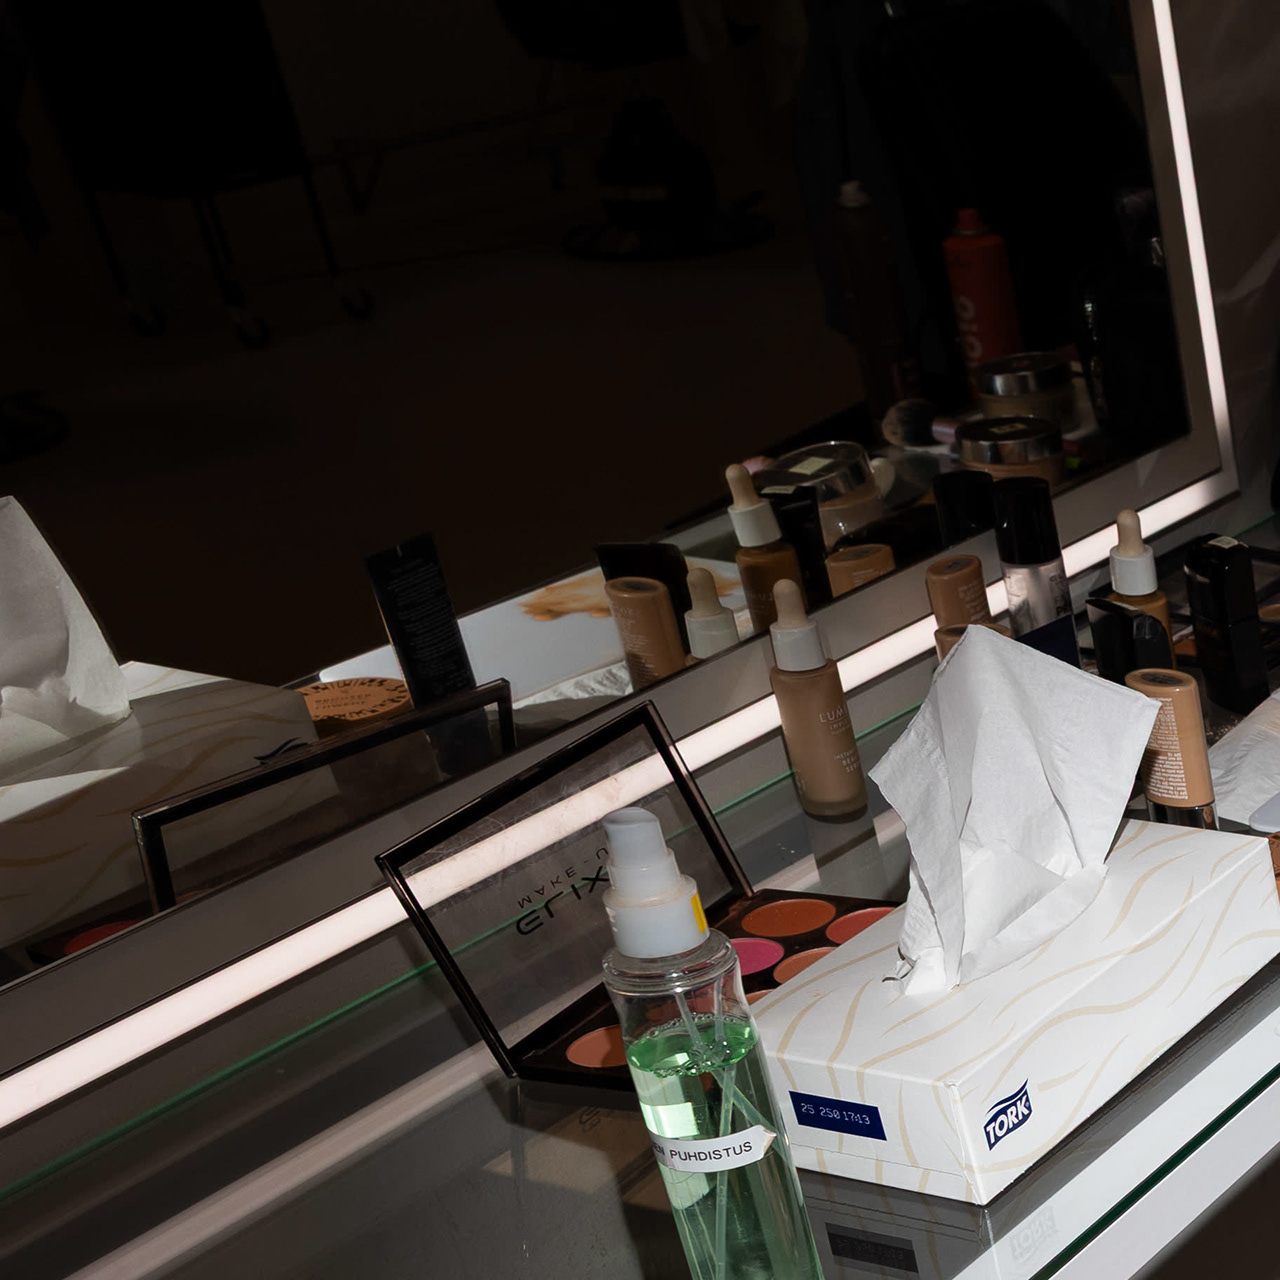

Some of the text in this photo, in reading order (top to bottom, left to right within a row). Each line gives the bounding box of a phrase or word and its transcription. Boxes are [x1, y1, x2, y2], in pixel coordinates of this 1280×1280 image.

[801, 1103, 815, 1115] 25
[819, 1106, 841, 1120] 250
[985, 1094, 1031, 1145] TORK
[670, 1141, 754, 1162] PUHDISTUS
